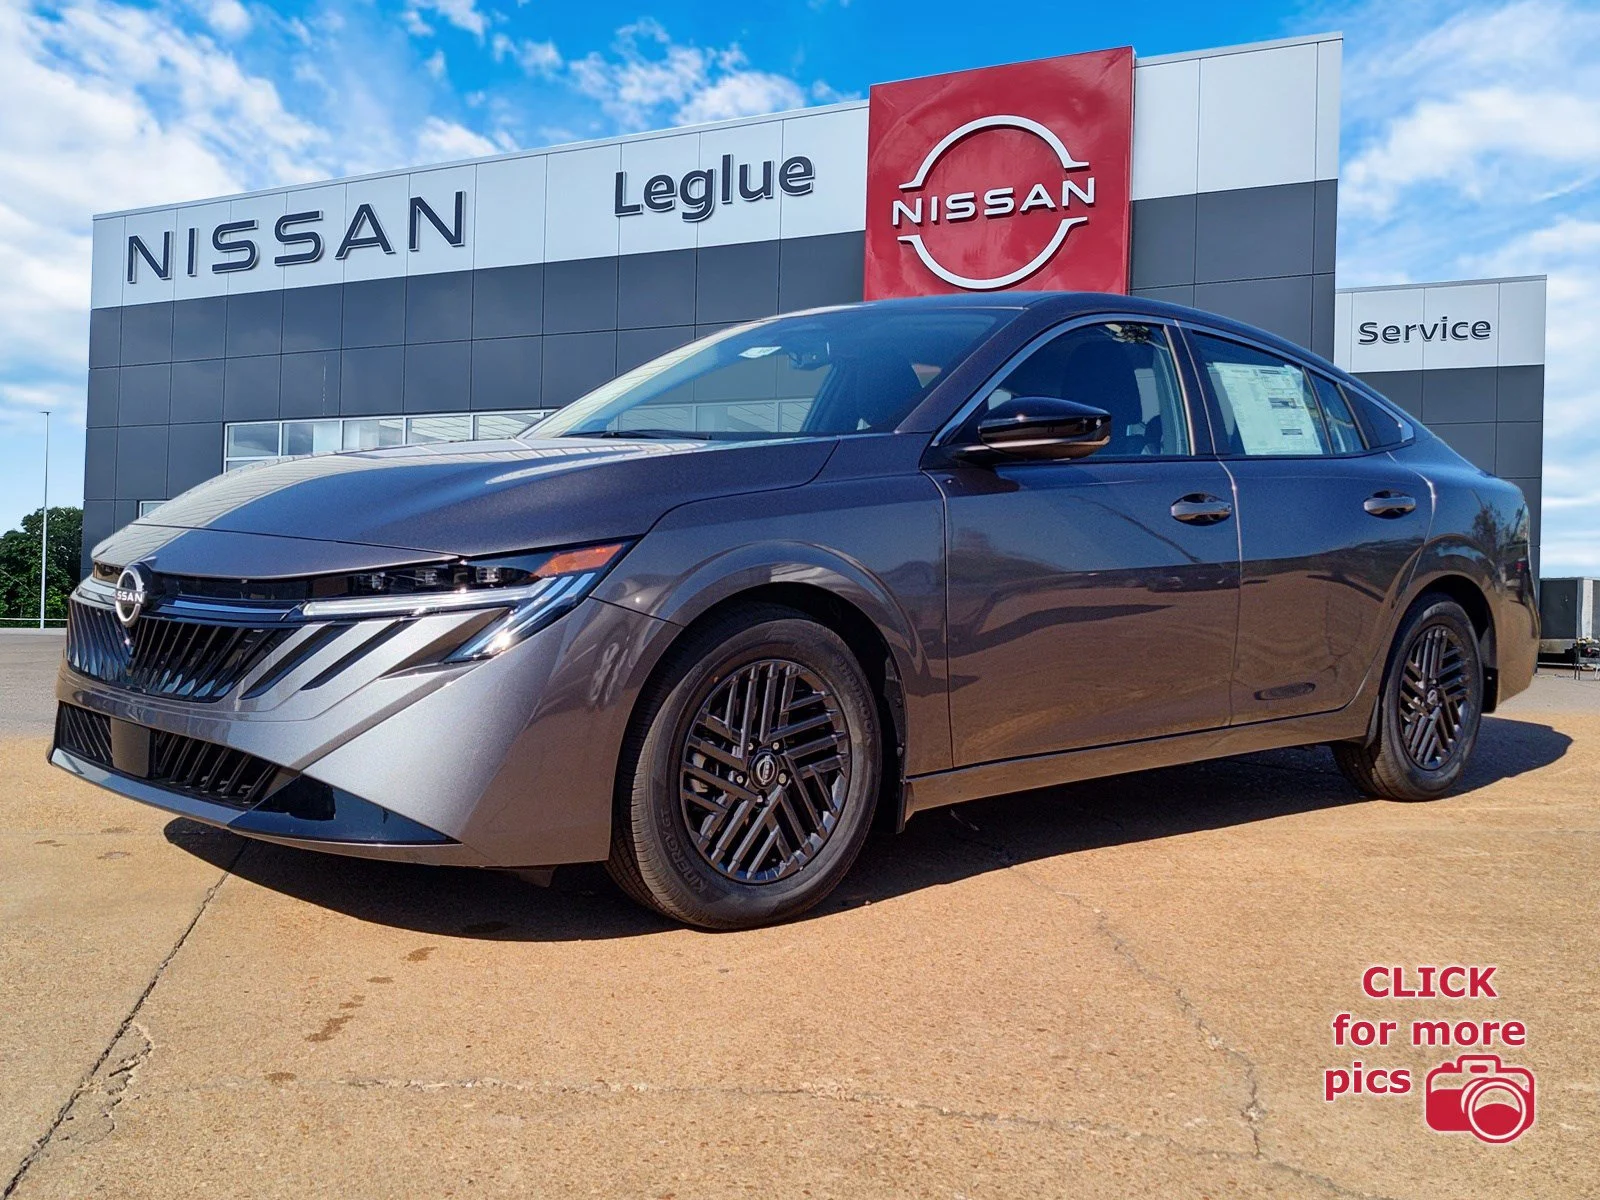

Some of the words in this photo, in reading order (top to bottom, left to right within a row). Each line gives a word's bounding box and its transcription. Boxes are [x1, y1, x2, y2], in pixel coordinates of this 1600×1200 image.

[614, 154, 815, 222] Leglue
[893, 177, 1095, 226] NISSAN
[127, 191, 465, 283] NISSAN
[1358, 316, 1491, 345] Service
[116, 590, 144, 603] SSAN
